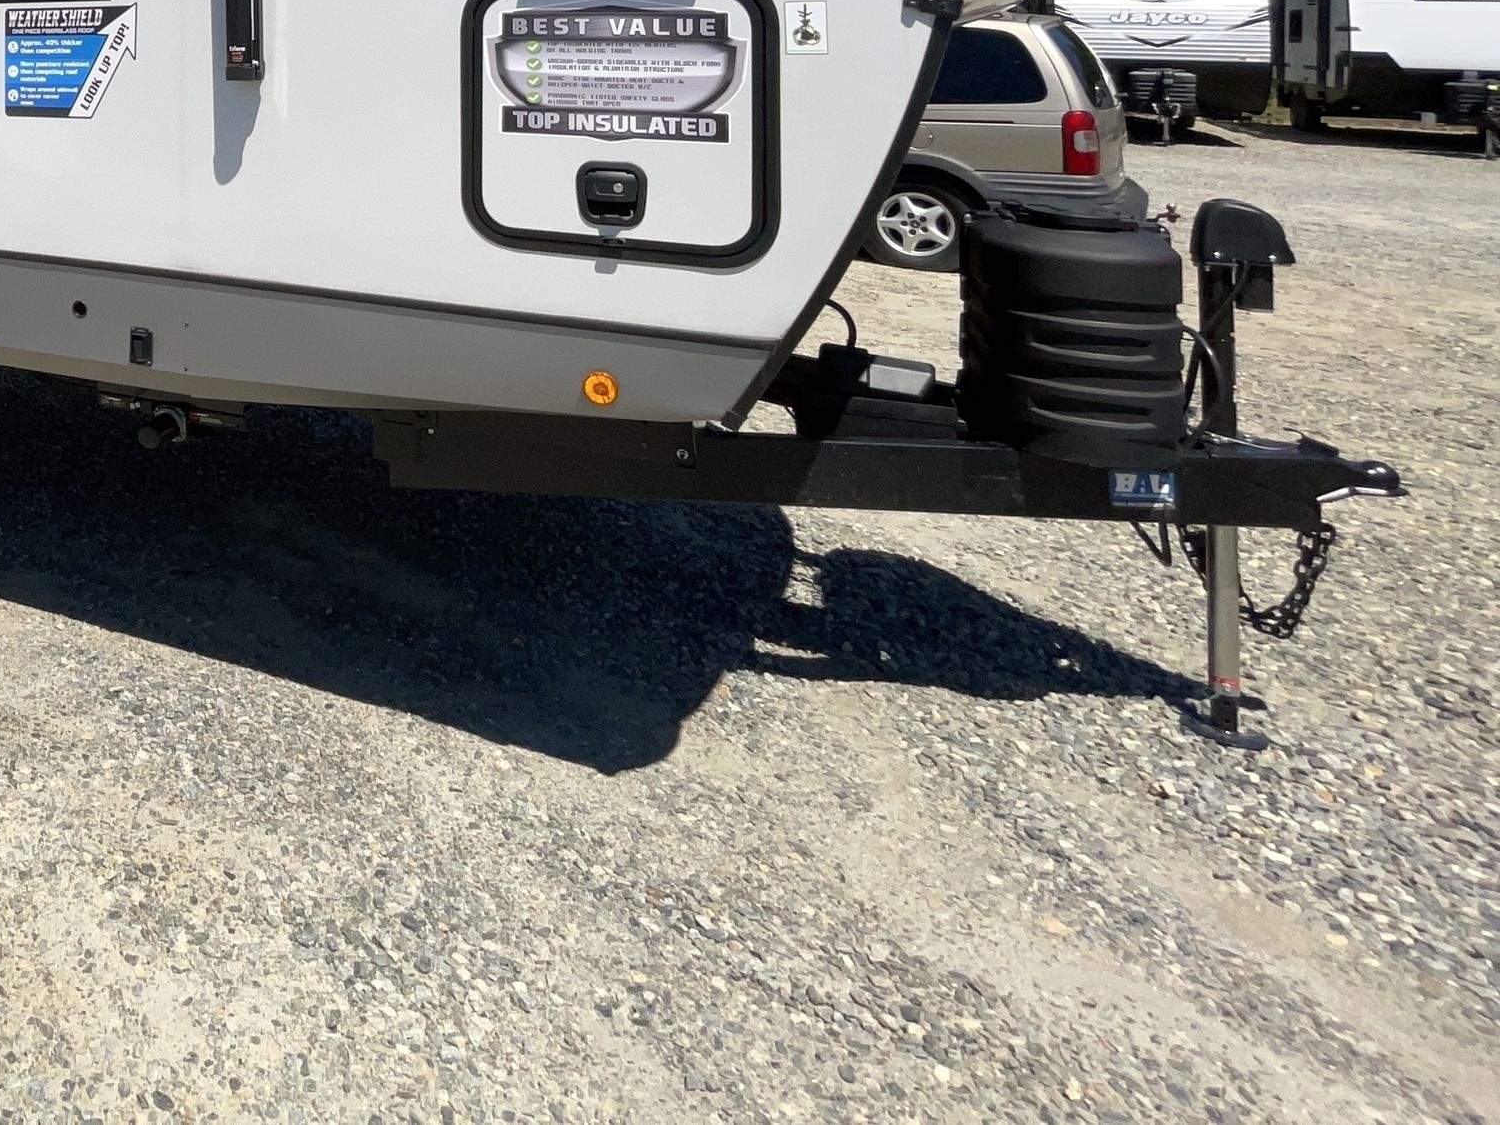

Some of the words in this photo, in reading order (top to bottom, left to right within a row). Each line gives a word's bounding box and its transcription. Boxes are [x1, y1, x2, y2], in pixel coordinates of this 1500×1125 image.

[512, 17, 590, 35] BEST
[608, 17, 717, 37] VALUE
[1108, 8, 1209, 26] Jayco
[80, 77, 102, 111] LOOK
[98, 55, 112, 75] UP
[108, 22, 130, 52] TOP!
[512, 109, 560, 130] TOP
[568, 111, 717, 137] INSULATED
